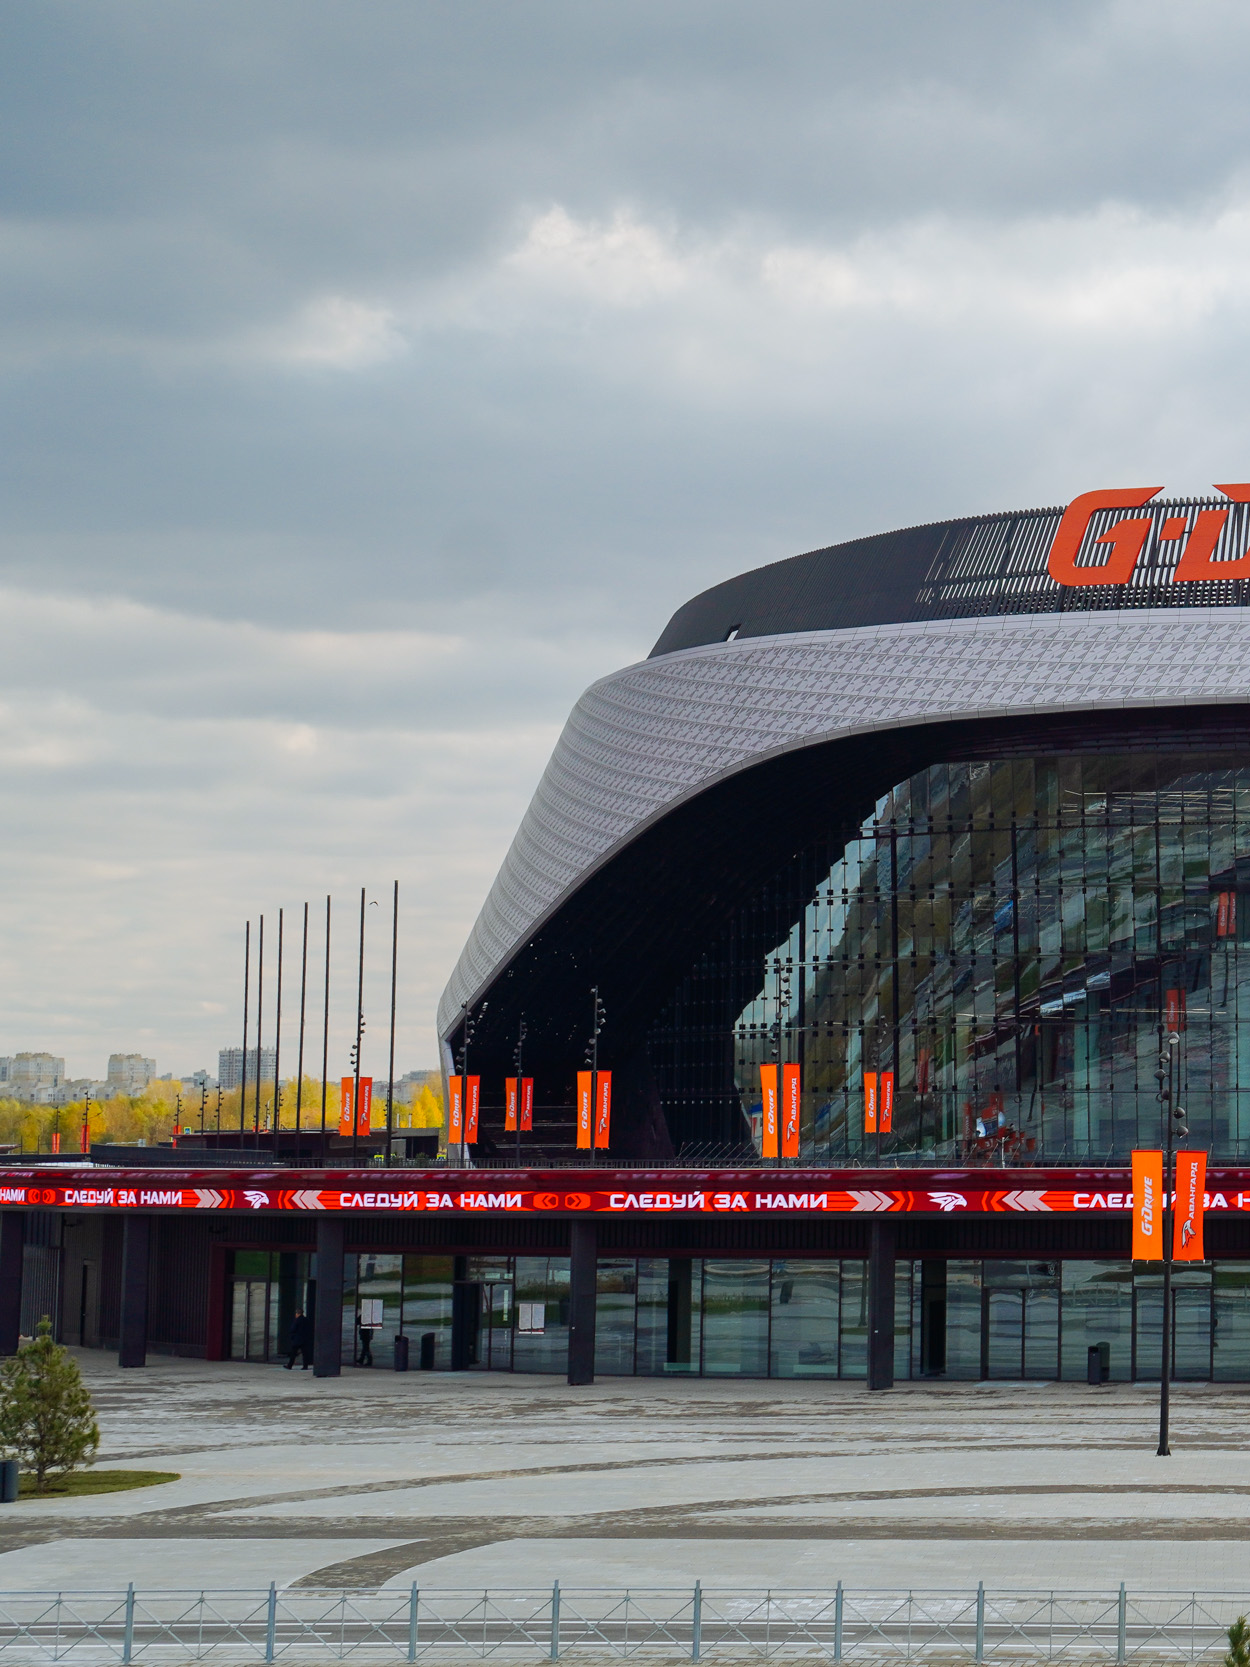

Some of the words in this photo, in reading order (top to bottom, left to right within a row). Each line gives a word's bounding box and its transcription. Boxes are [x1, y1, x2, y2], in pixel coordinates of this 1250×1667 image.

[0, 1189, 25, 1202] НАМИ
[64, 1188, 114, 1204] СЛЕДУЙ
[118, 1189, 136, 1204] ЗА
[141, 1191, 182, 1205] НАМИ
[340, 1190, 418, 1208] СЛЕДУЙ
[427, 1193, 453, 1208] ЗА
[461, 1193, 522, 1208] НАМИ
[610, 1190, 704, 1208] СЛЕДУЙ
[715, 1194, 747, 1208] ЗА
[756, 1193, 827, 1208] НАМИ
[1188, 1162, 1198, 1219] АВАНГАРД
